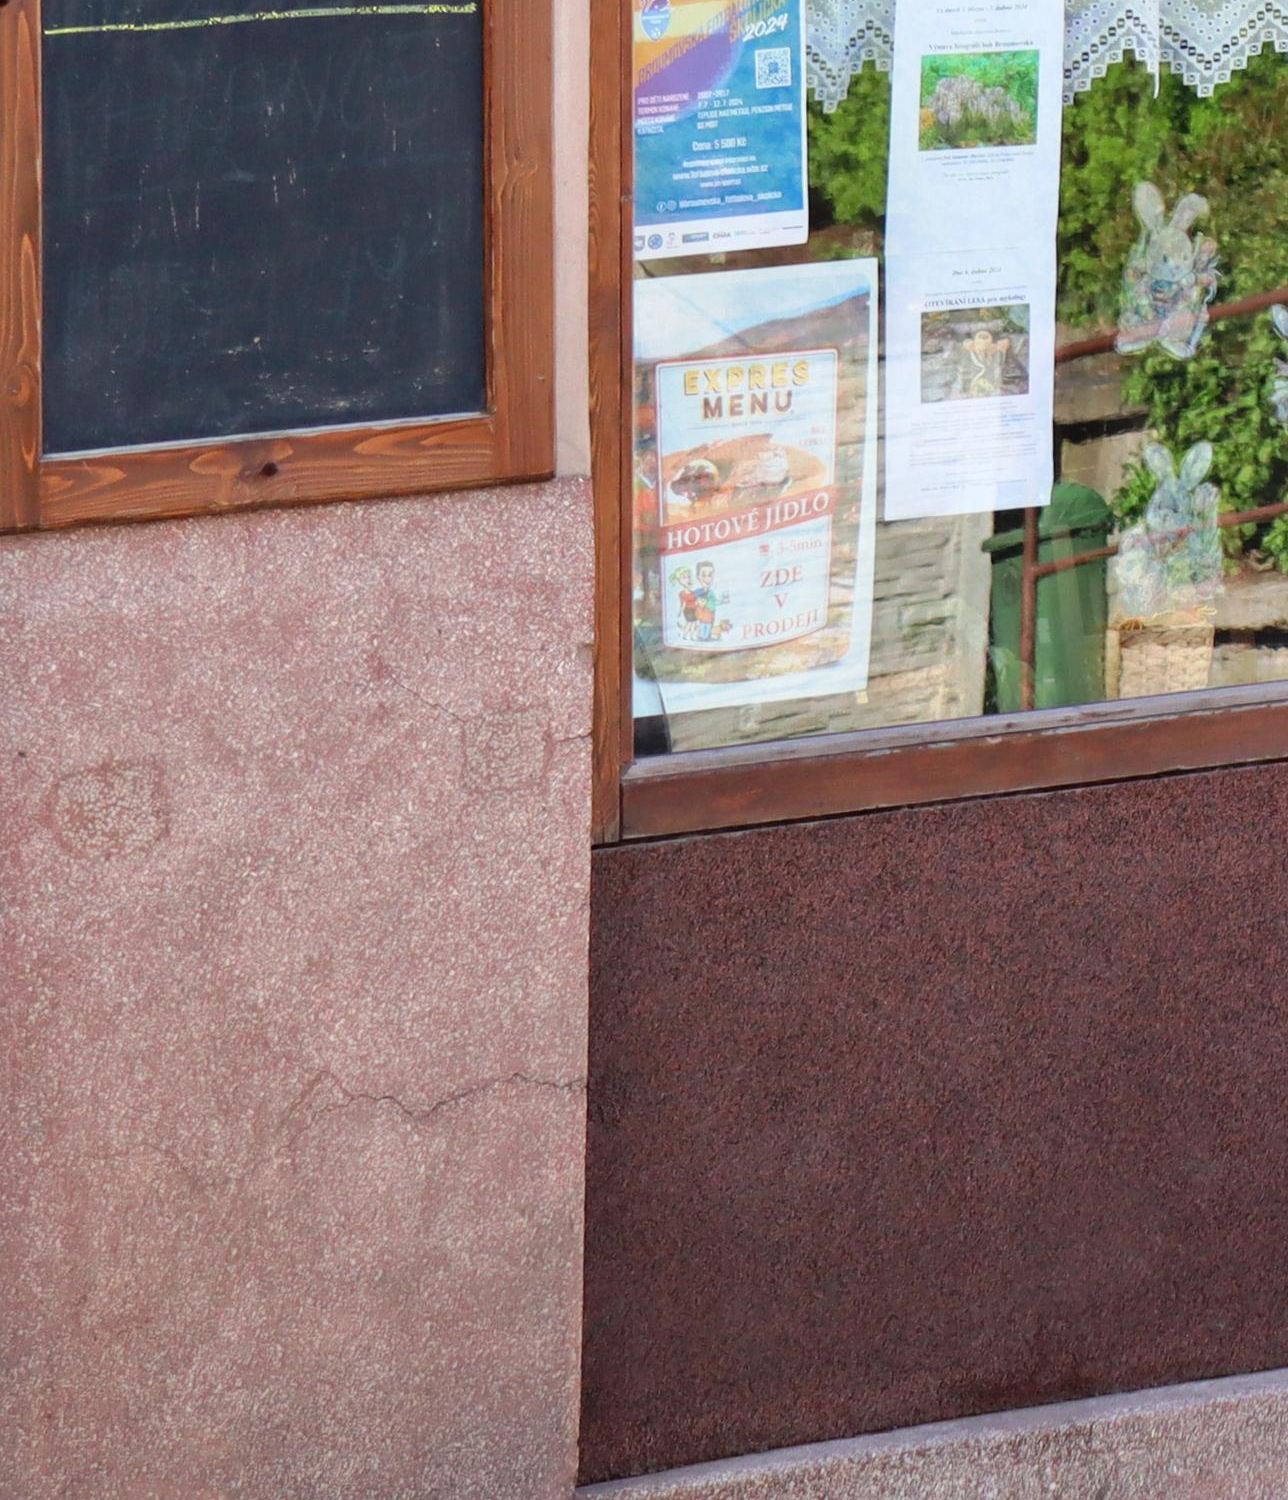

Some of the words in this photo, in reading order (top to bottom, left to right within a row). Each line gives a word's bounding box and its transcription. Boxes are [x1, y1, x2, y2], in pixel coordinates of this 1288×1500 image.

[742, 12, 789, 43] 2024
[683, 359, 810, 396] EXPRES
[702, 390, 793, 420] MENU
[667, 507, 761, 550] HOTOVÉ
[764, 491, 830, 531] JÍDLO
[760, 565, 804, 588] ZDE
[773, 592, 790, 609] V
[743, 608, 820, 639] PRODEJI
